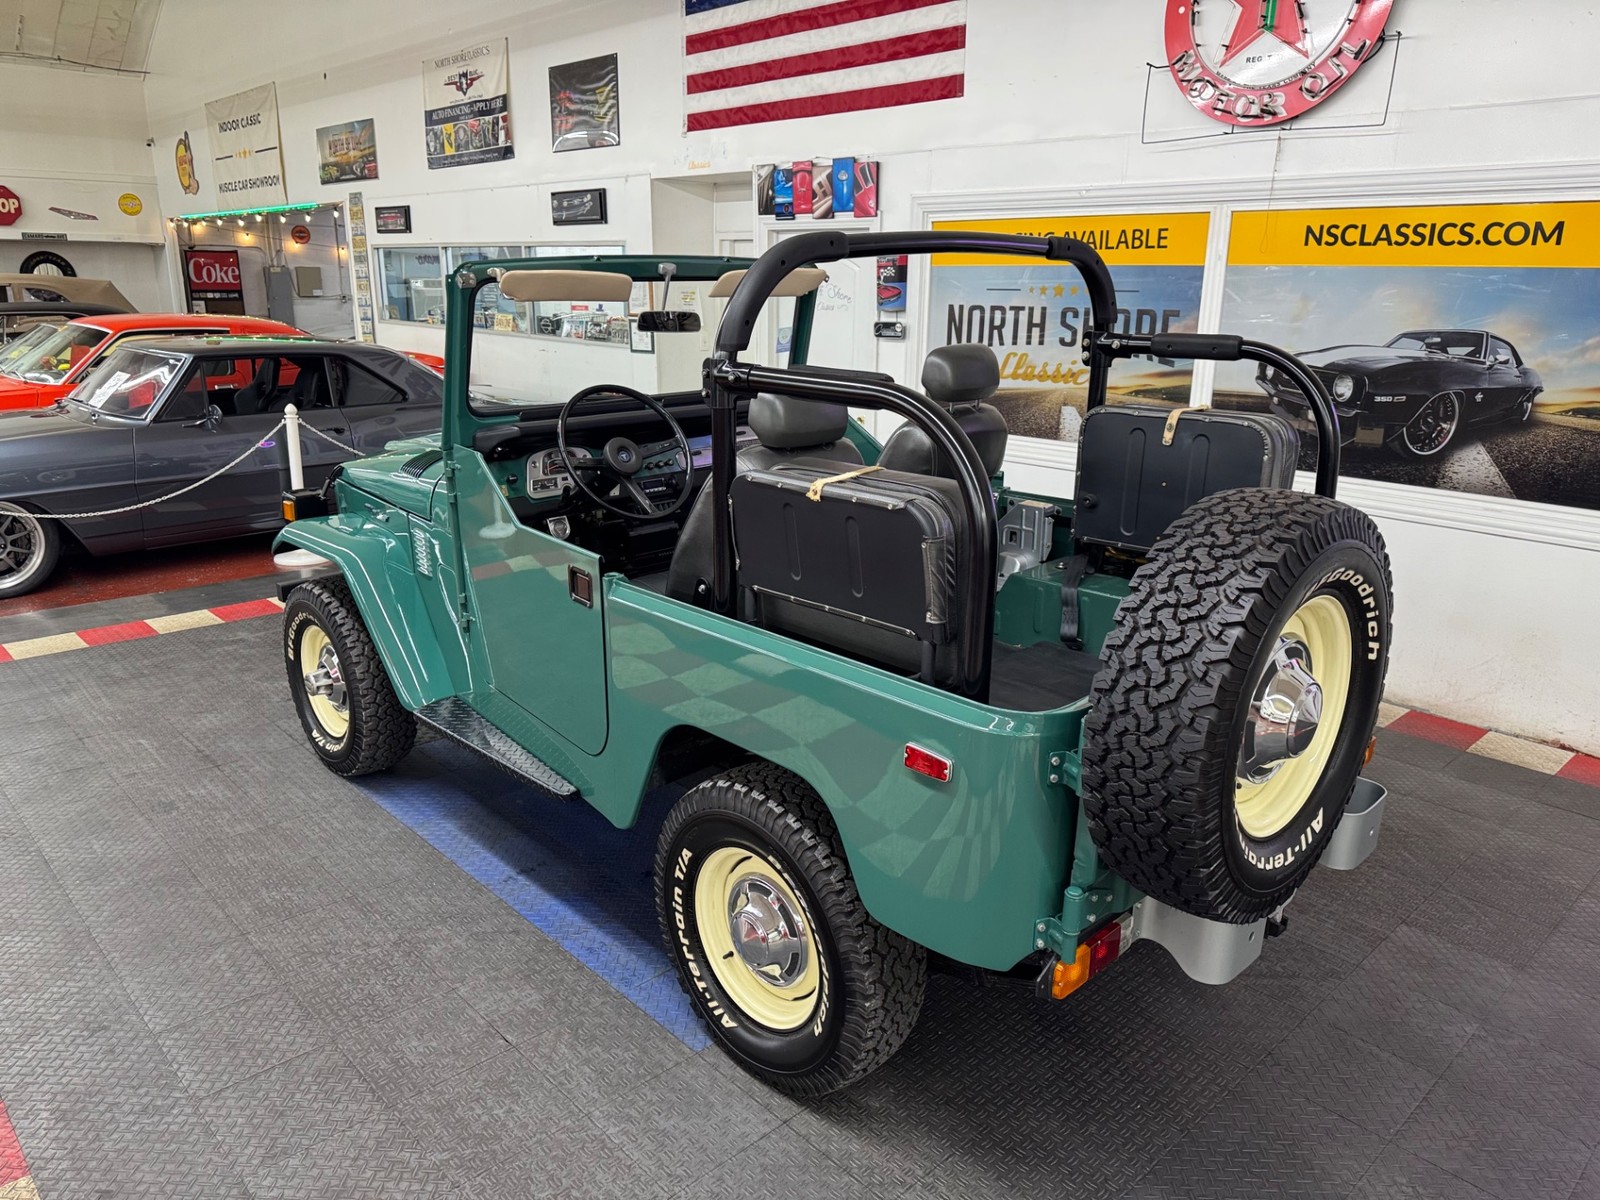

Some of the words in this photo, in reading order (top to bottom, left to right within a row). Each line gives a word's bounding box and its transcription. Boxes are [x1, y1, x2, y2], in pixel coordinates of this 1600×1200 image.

[1172, 50, 1286, 122] MOTOR
[1299, 38, 1371, 100] OIL
[432, 111, 444, 120] AUTO
[490, 97, 503, 109] HERE
[218, 119, 240, 133] INDOOR
[238, 179, 248, 191] CAR
[0, 198, 19, 213] OP
[1304, 220, 1565, 247] NSCLASSICS.COM
[188, 257, 241, 284] Coke
[946, 303, 1048, 347] NORTH
[1373, 395, 1393, 403] 350
[674, 847, 693, 881] T/A
[672, 886, 739, 1030] All-Terrain
